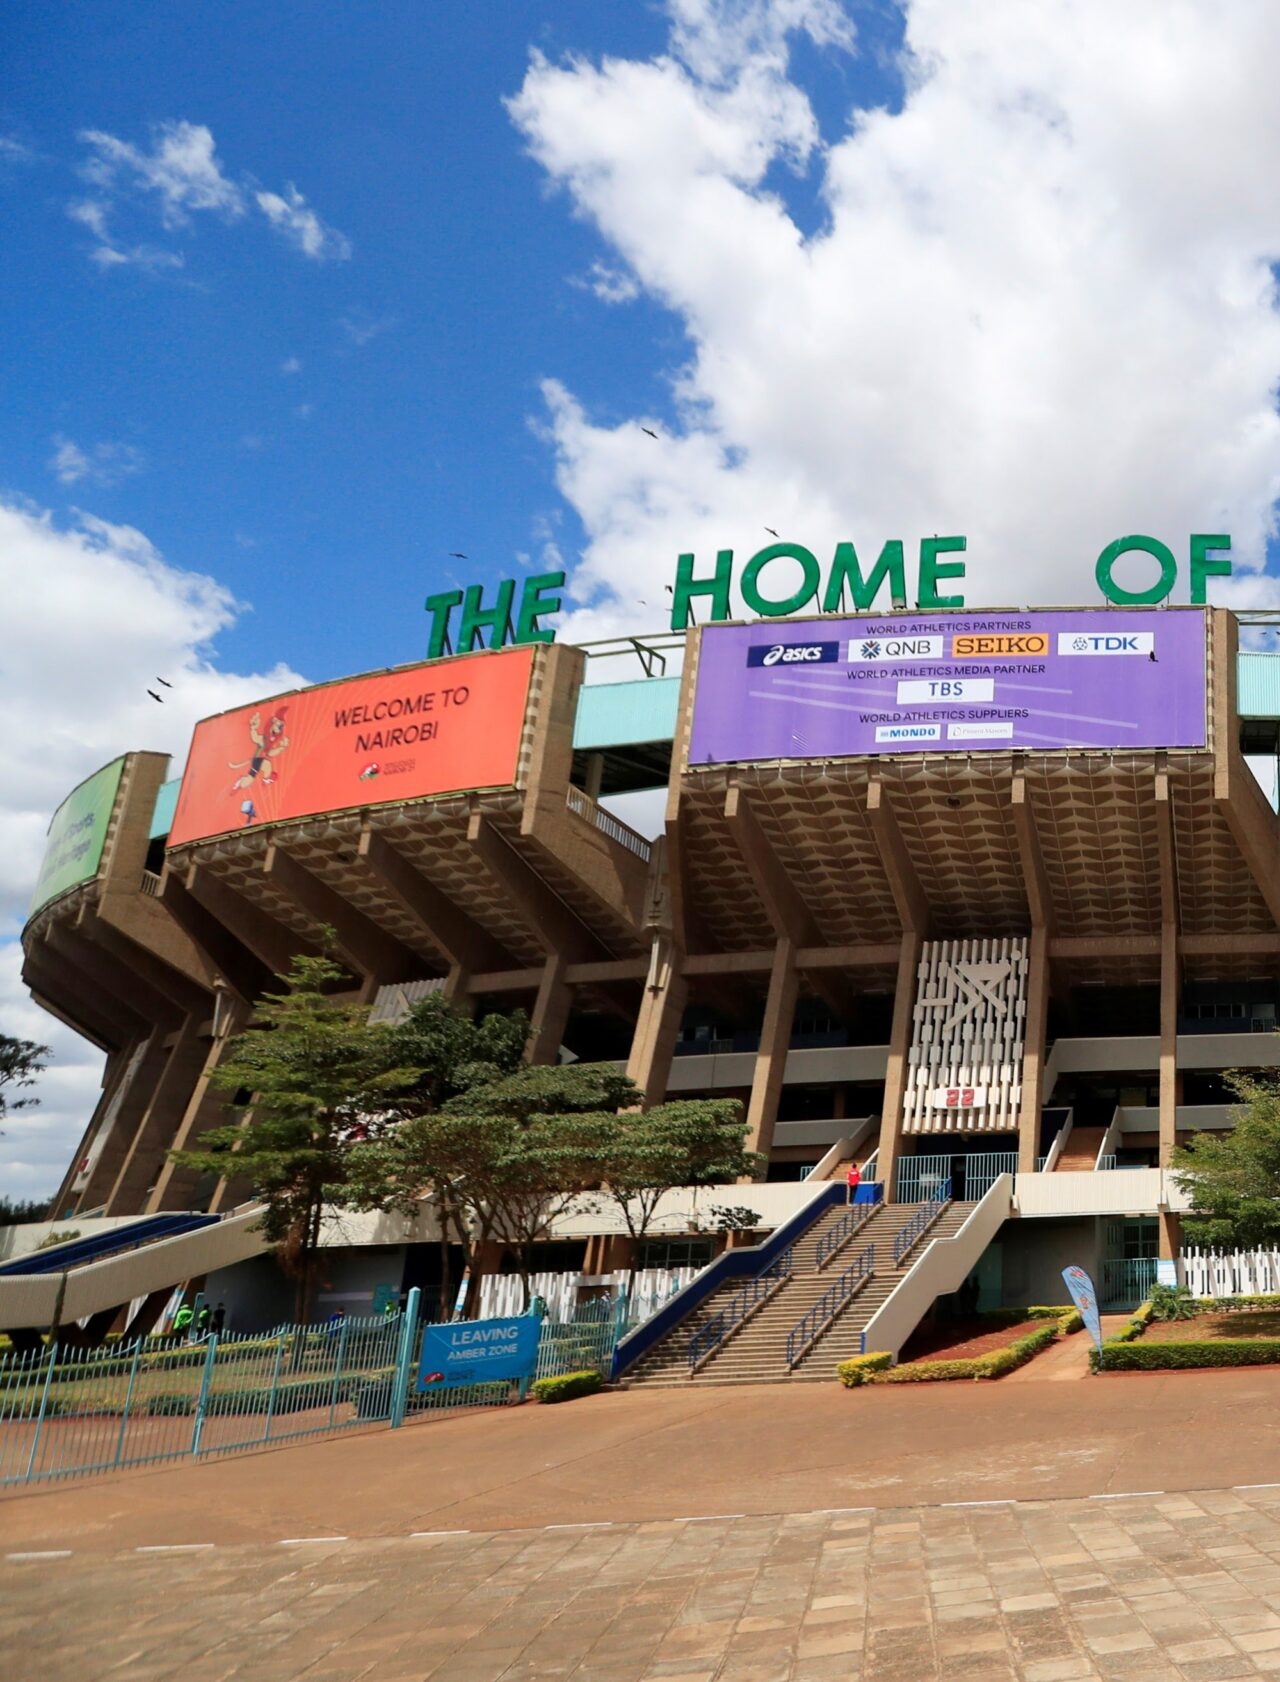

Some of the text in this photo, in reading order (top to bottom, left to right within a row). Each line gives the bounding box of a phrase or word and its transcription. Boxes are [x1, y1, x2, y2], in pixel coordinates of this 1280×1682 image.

[425, 571, 566, 659] THE
[671, 536, 967, 630] HOME
[1095, 534, 1232, 605] OF
[866, 620, 1032, 635] WORLD ATHLETICS PARTNERS
[886, 640, 931, 656] QNB
[956, 636, 1045, 654] SEIKO
[1088, 636, 1139, 651] TDK
[782, 646, 823, 661] asics
[847, 664, 1046, 680] WORLD ATHLETICS MEDIA PARTNER
[928, 681, 963, 697] TBS
[334, 686, 470, 728] WELCOME TO
[859, 708, 1029, 723] WORLD ATHLETICS SUPPLIERS
[355, 721, 439, 753] NAIROBI
[889, 727, 936, 738] MONDO
[946, 1088, 975, 1107] 22
[451, 1326, 519, 1346] LEAVING
[447, 1343, 518, 1360] AMBER ZONE
